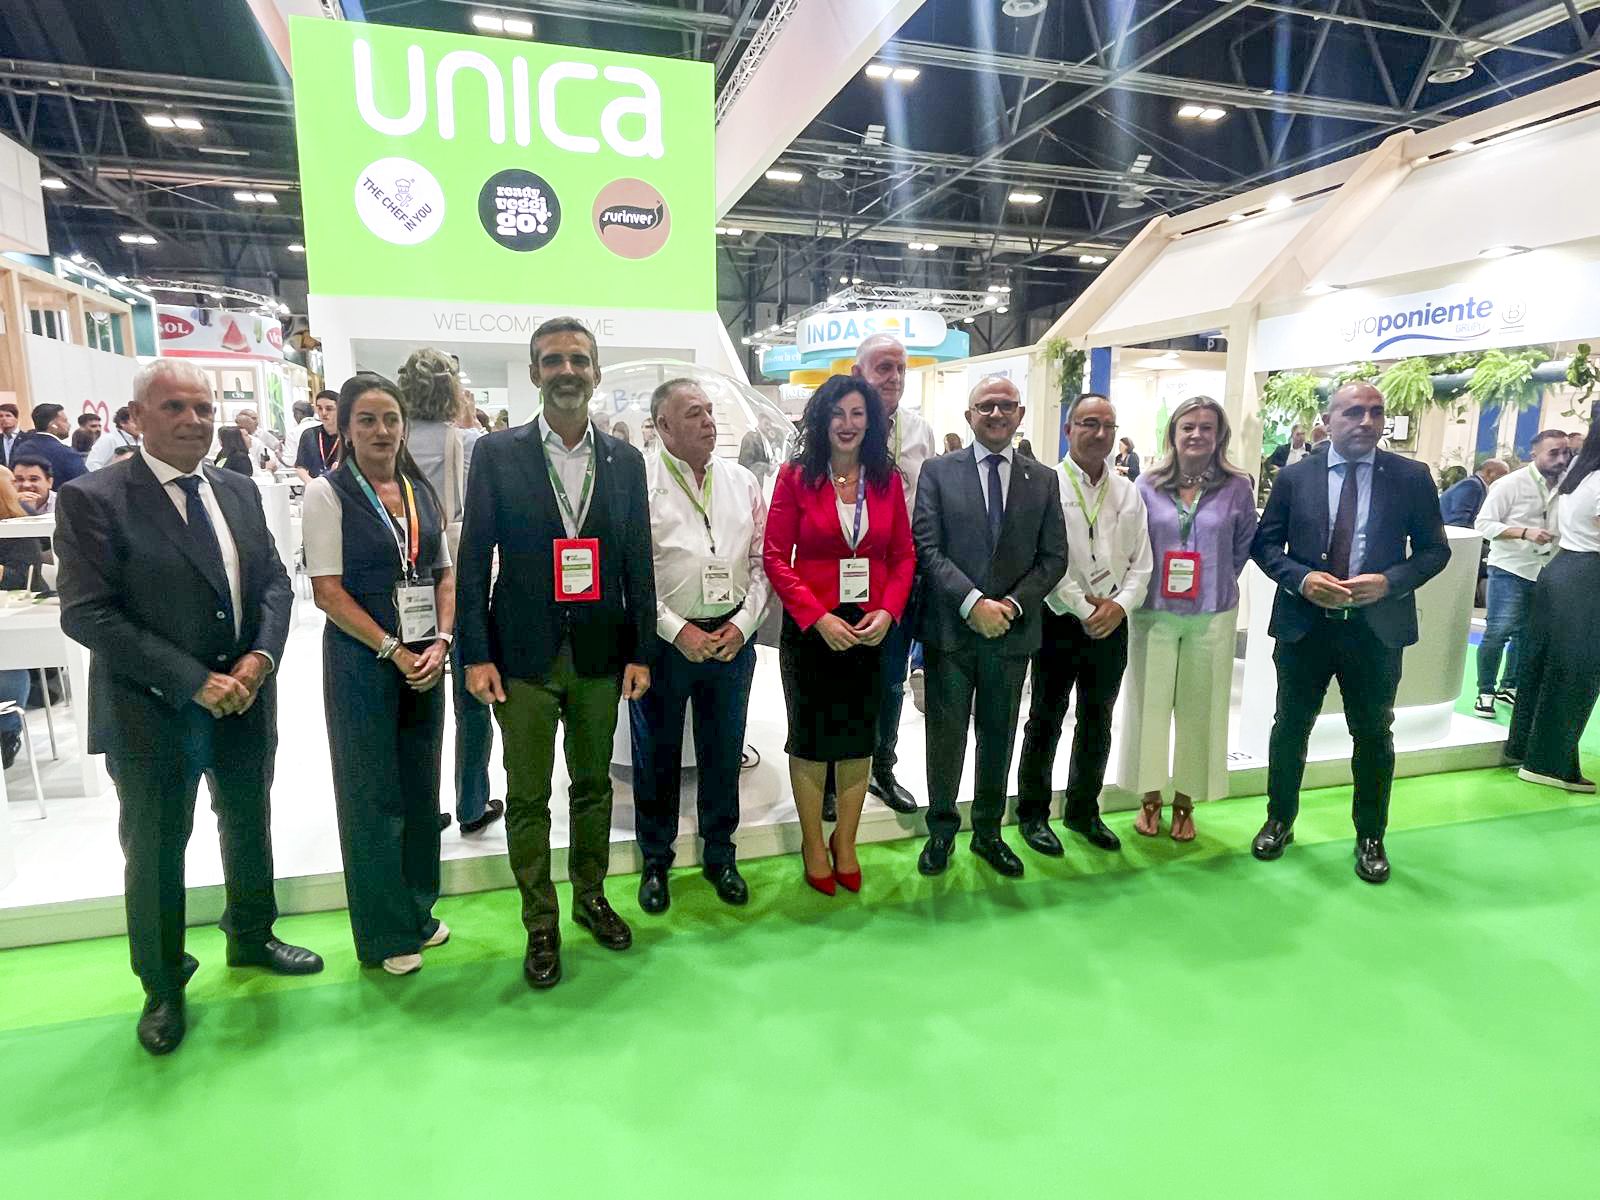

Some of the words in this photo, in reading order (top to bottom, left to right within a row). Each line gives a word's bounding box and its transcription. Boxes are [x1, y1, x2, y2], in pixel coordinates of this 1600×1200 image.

[363, 177, 385, 200] THE
[381, 197, 409, 221] CHEF
[496, 186, 540, 199] ready
[495, 196, 548, 214] veggi
[403, 218, 417, 232] IN
[412, 203, 432, 223] YOU
[602, 210, 653, 226] surinver
[433, 312, 544, 333] WELCOME
